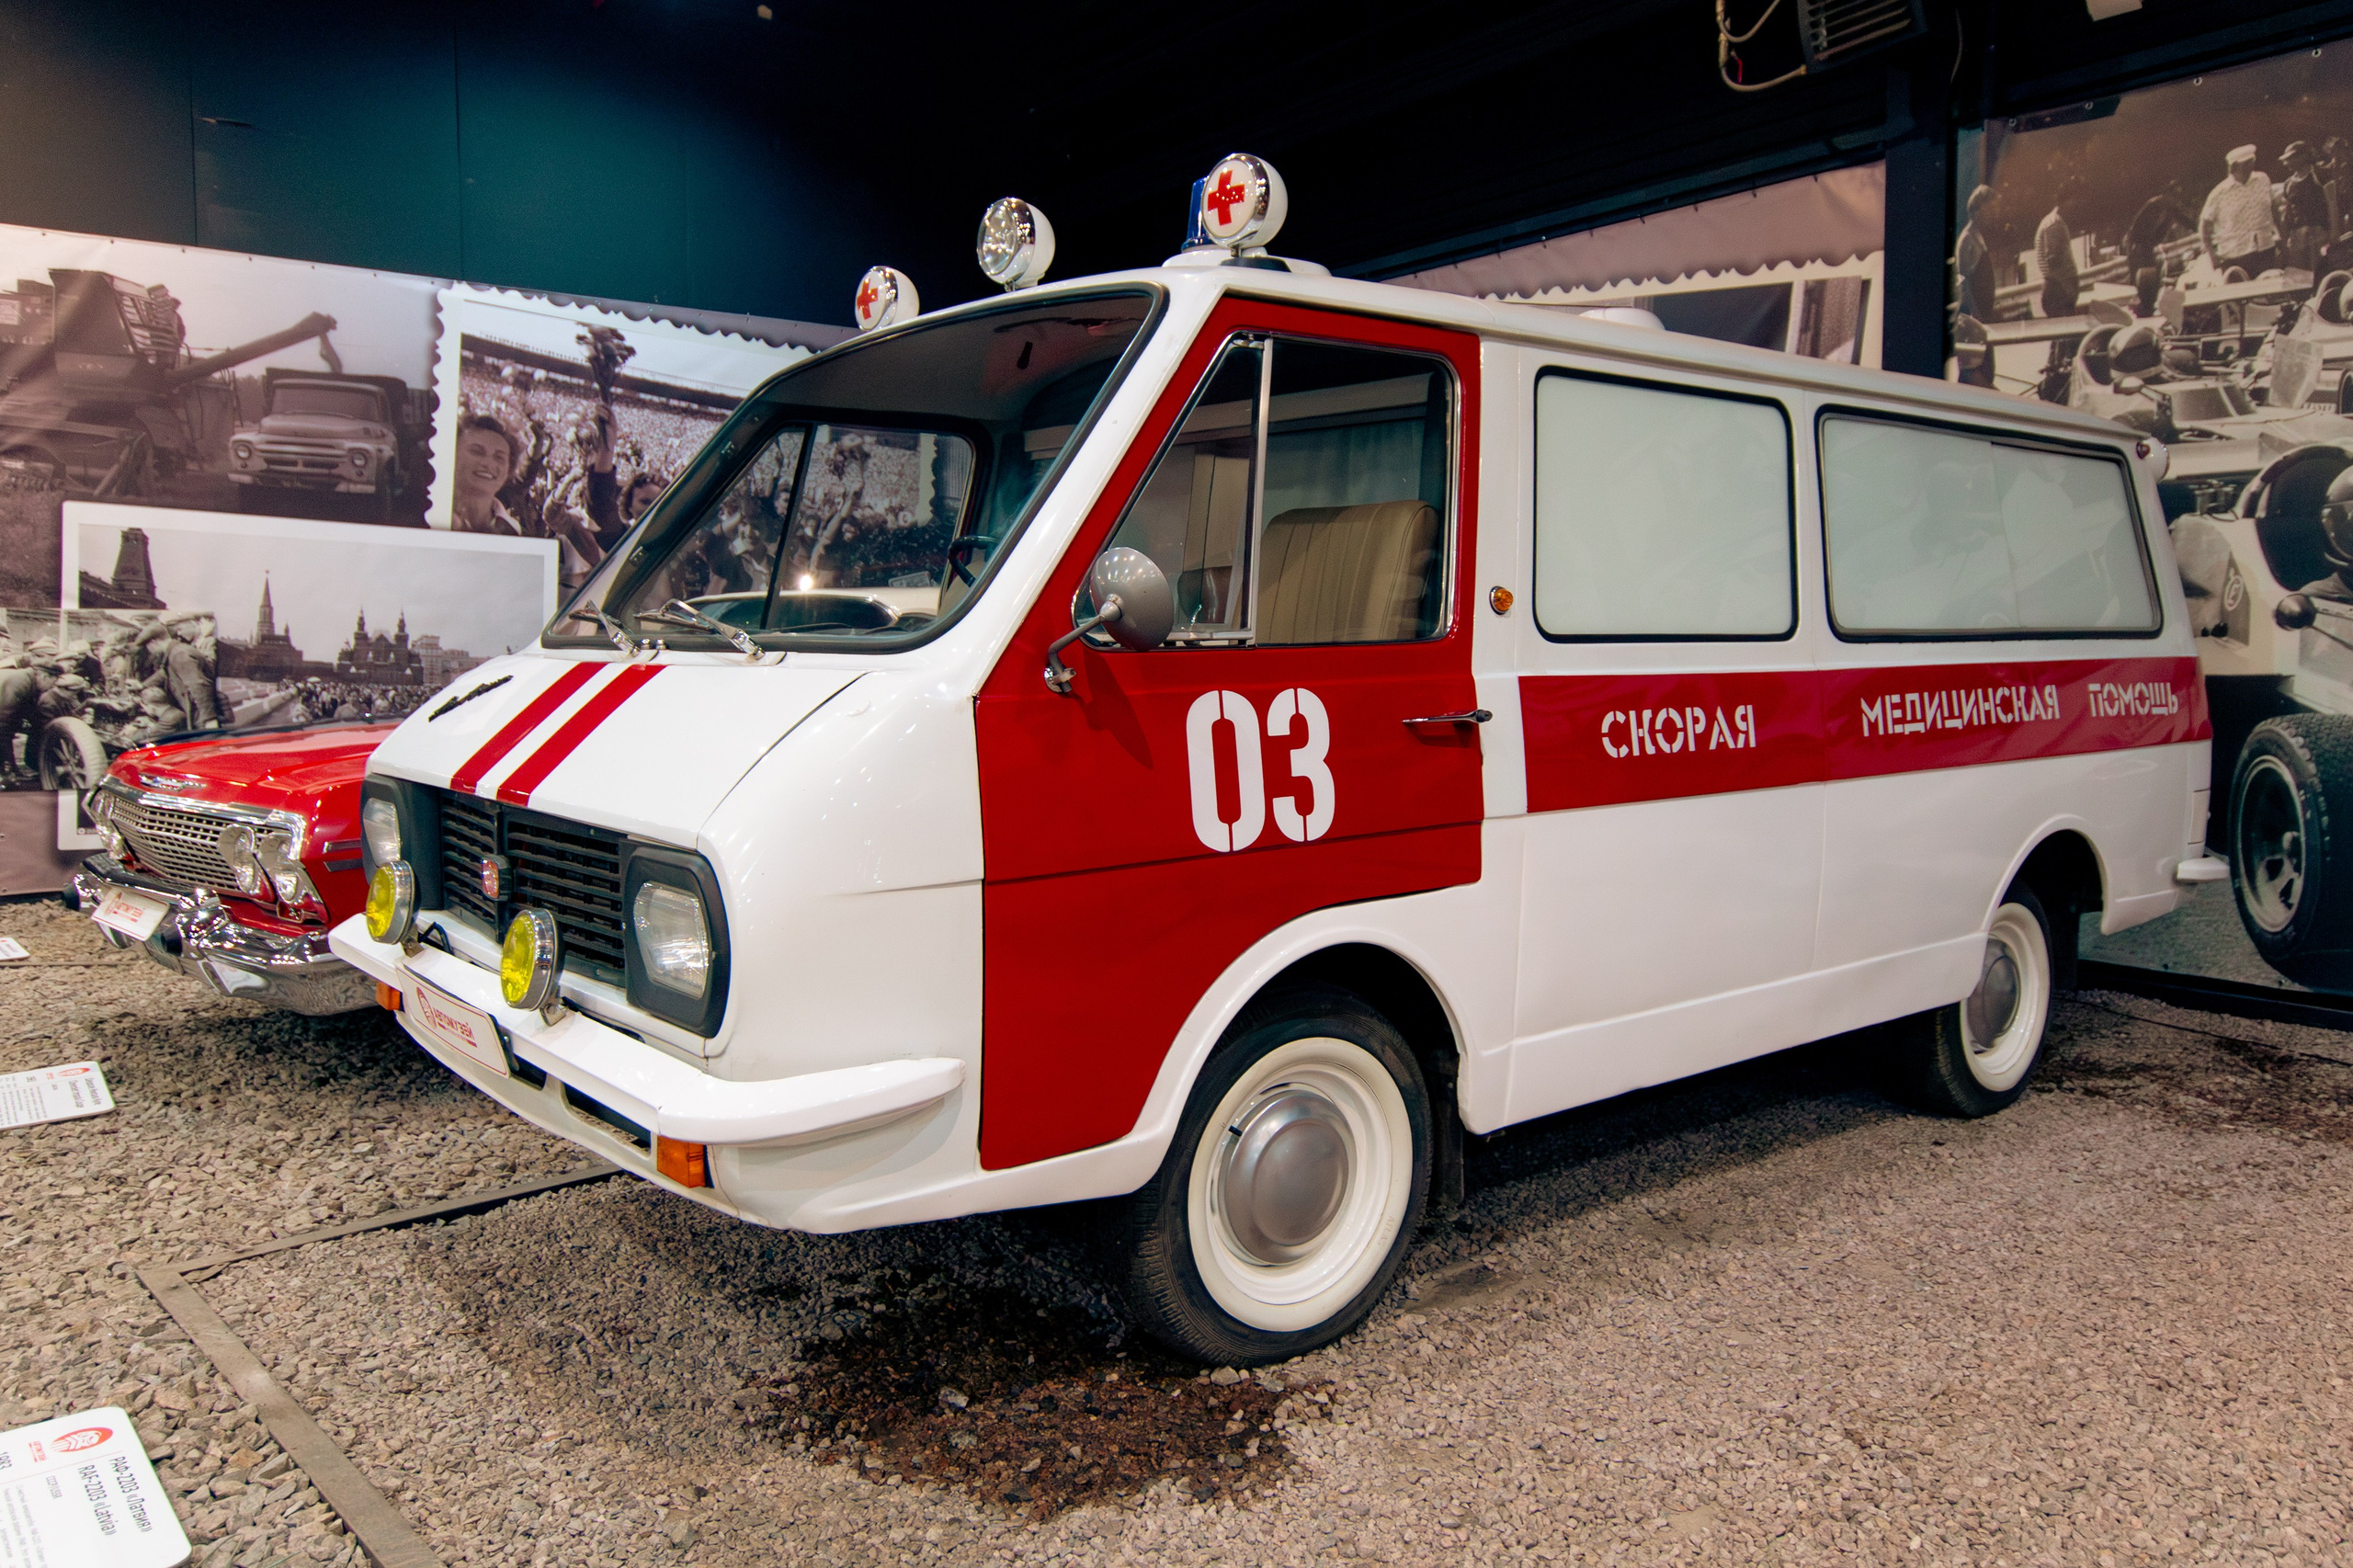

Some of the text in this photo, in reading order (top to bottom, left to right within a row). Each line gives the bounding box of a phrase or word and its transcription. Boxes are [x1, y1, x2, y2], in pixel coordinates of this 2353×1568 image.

[1601, 682, 2179, 758] СКОРАЯ МЕДИЦИНСКАЯ ПОМОЩЬ
[1186, 687, 1336, 852] 03
[77, 1464, 119, 1536] RAF-2203 «Latvia»
[108, 1456, 153, 1532] РАФ-2203 «Латвия»
